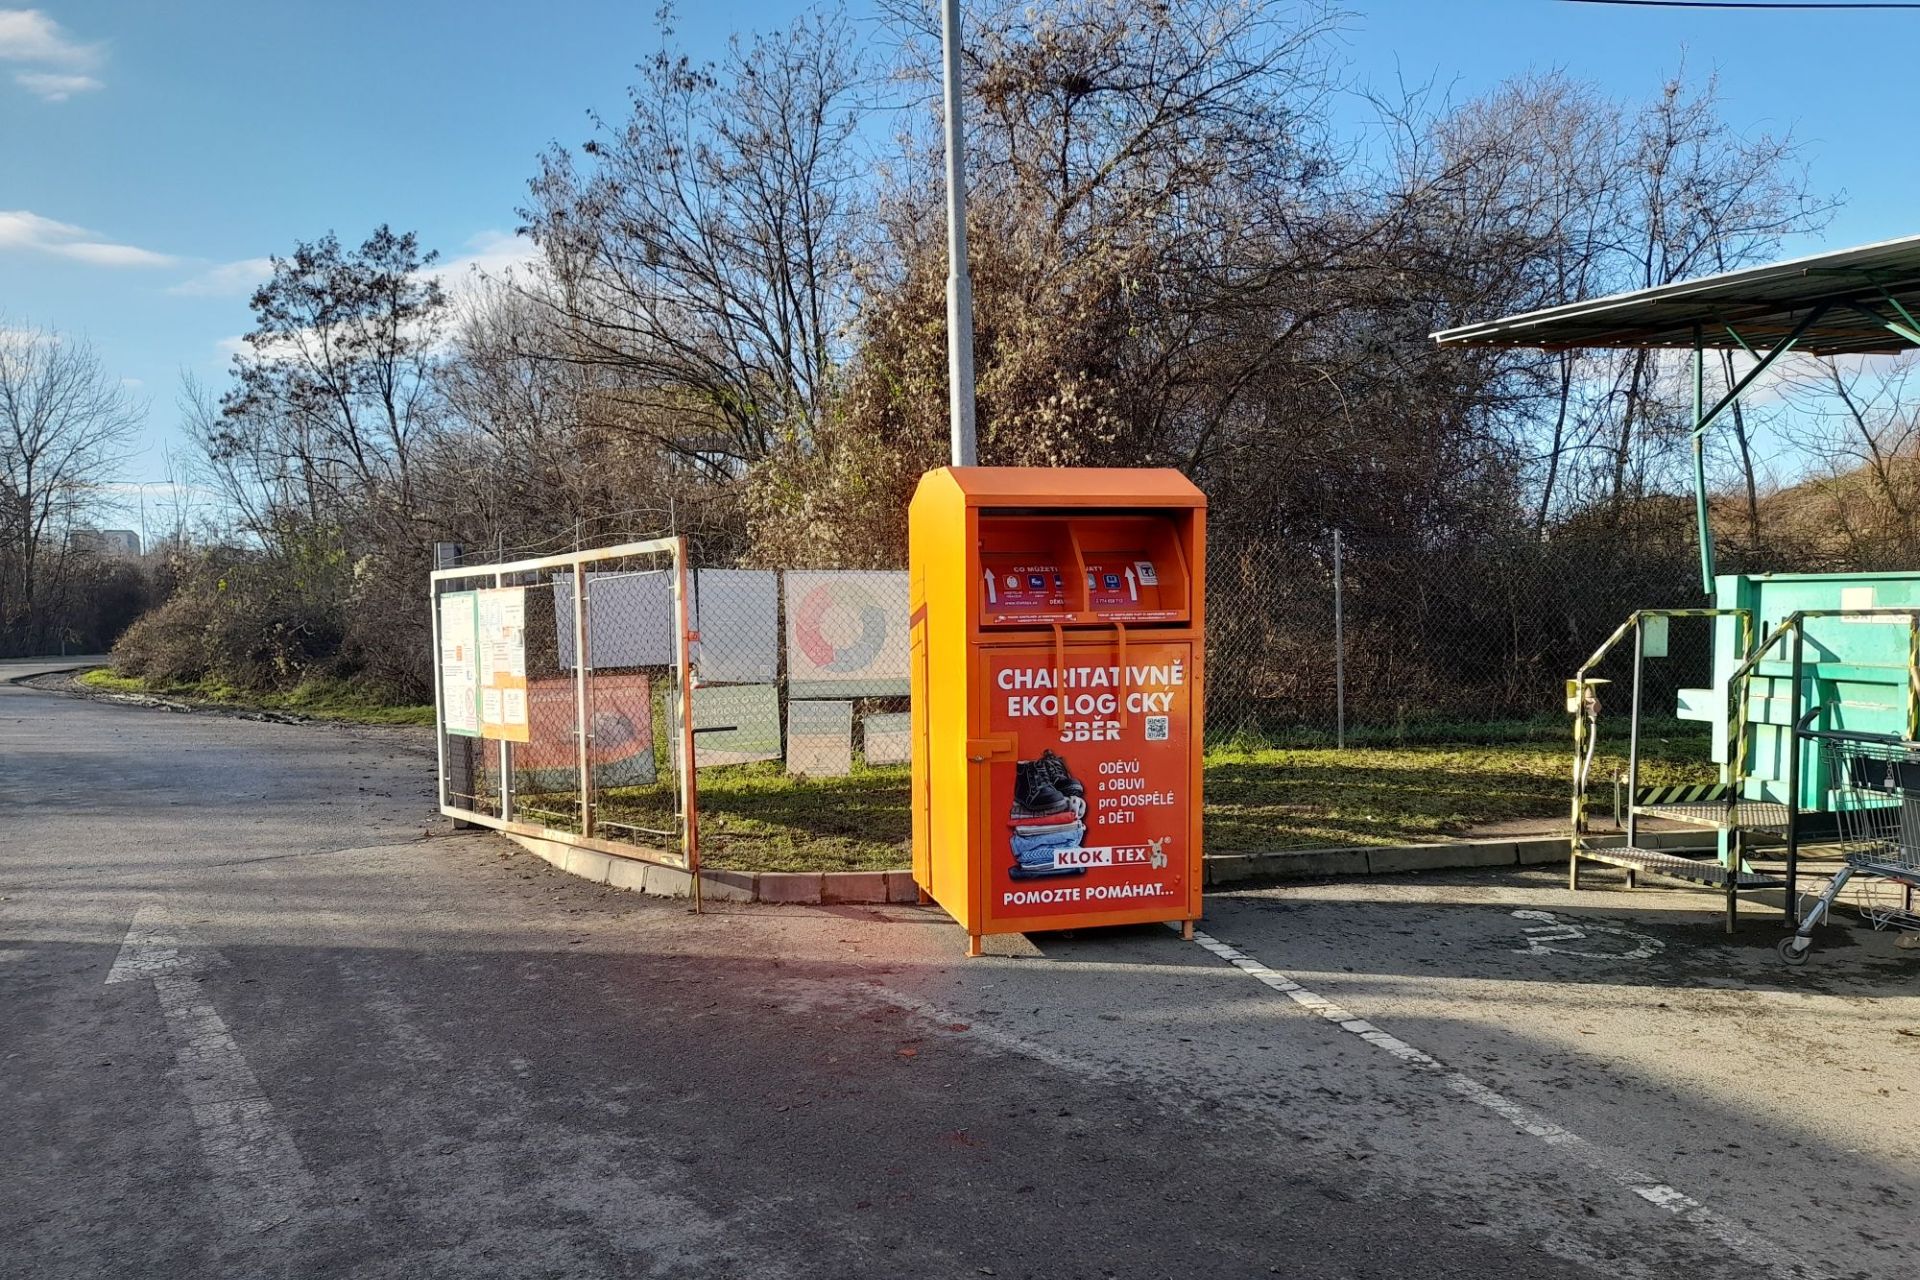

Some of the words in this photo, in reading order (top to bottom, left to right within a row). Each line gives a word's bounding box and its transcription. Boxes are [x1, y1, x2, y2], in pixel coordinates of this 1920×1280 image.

[1060, 714, 1121, 742] SBĚR
[1098, 781, 1105, 791] a
[1108, 778, 1145, 790] OBUVI
[1098, 797, 1118, 809] pro
[1120, 790, 1174, 806] DOSPĚLÉ
[1098, 814, 1105, 824] a
[1108, 809, 1135, 824] DĚTI
[1003, 889, 1081, 906] POMOZTE
[1086, 881, 1174, 900] POMÁHAT...
